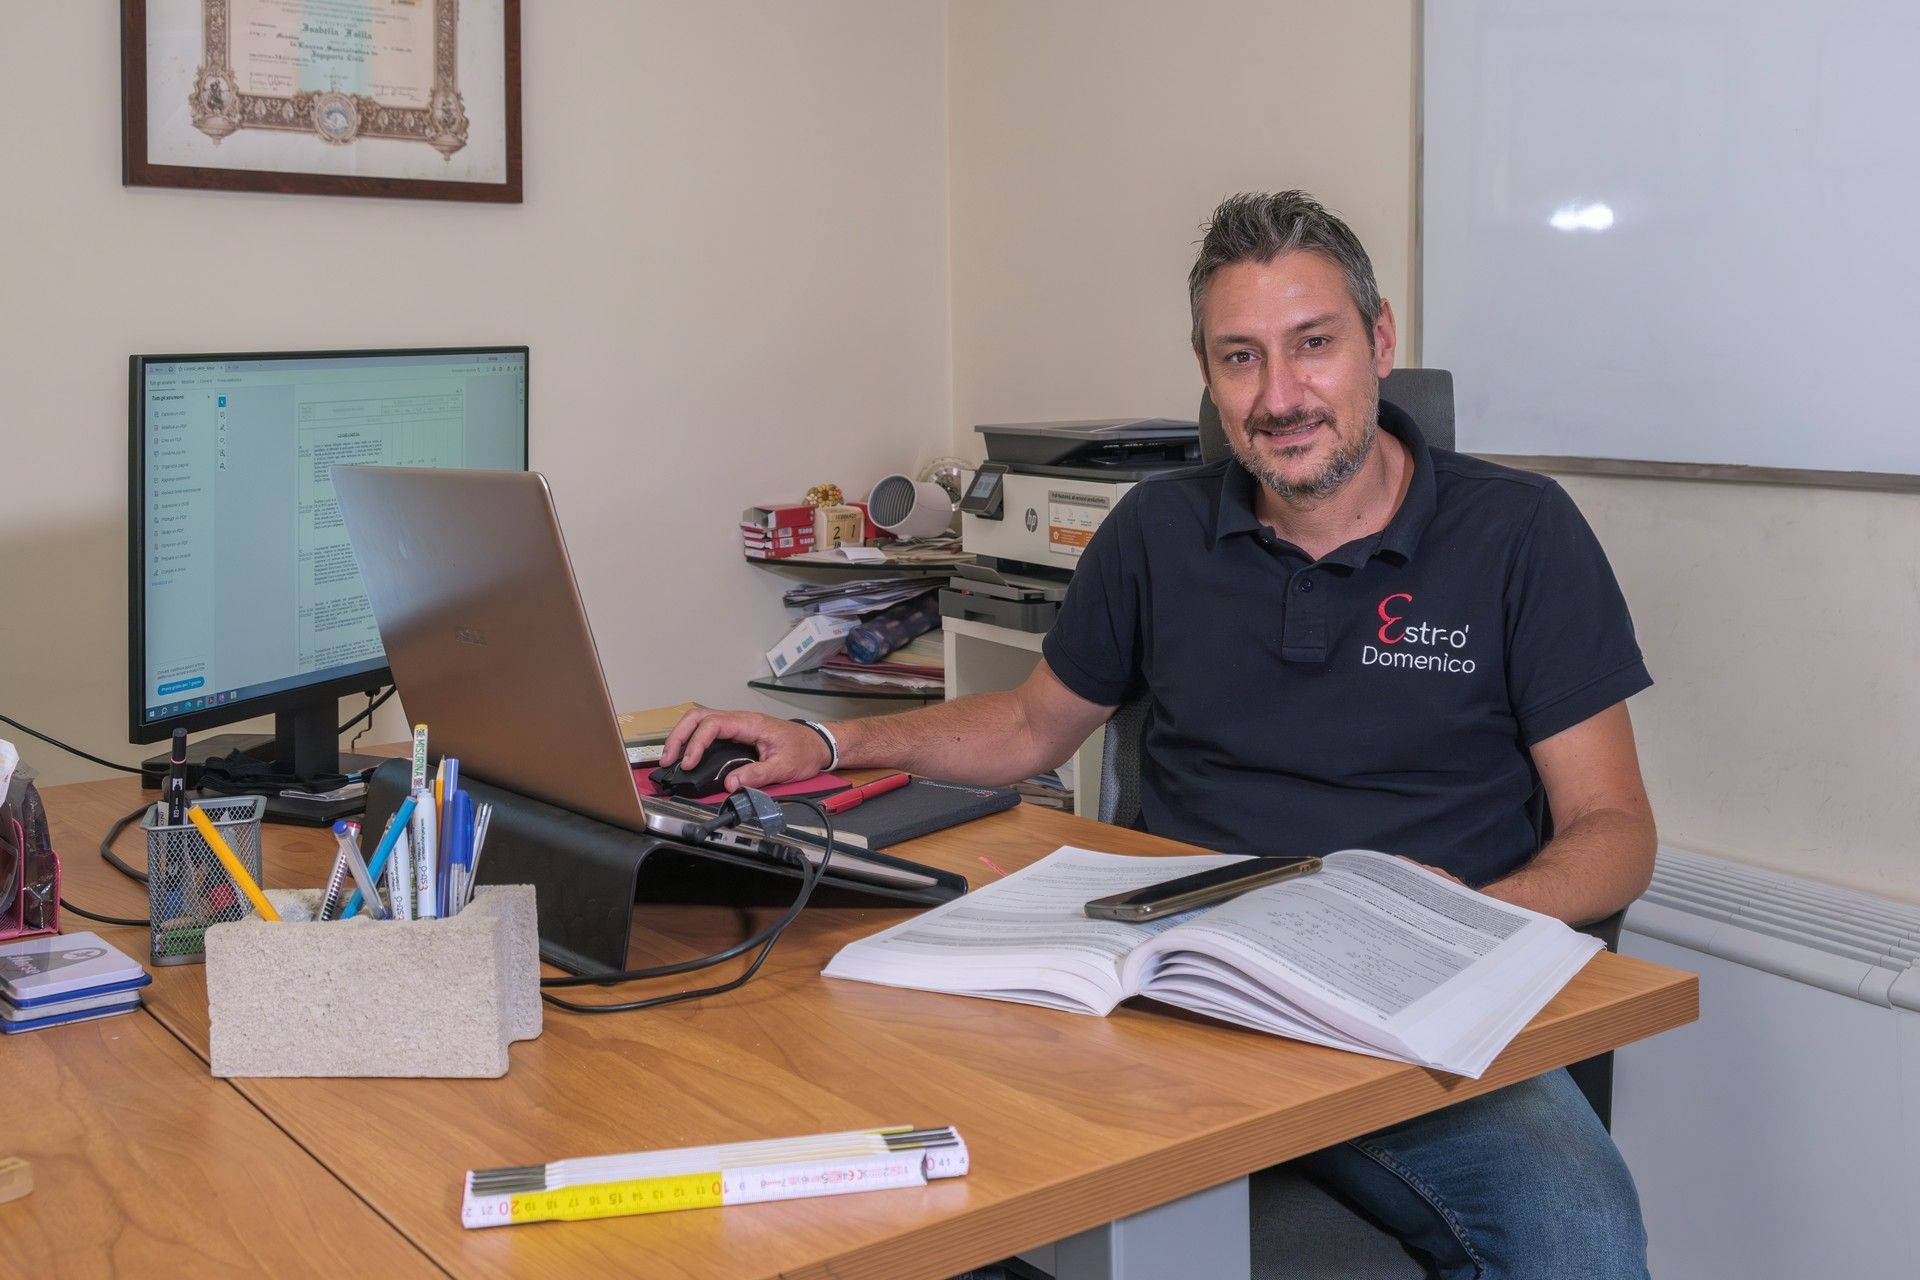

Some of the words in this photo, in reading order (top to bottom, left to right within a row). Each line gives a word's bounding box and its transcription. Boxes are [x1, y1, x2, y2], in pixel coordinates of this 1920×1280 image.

[1362, 645, 1476, 673] Domenico
[414, 739, 425, 777] MISURINA
[499, 1200, 520, 1216] 20
[609, 1192, 623, 1205] 15
